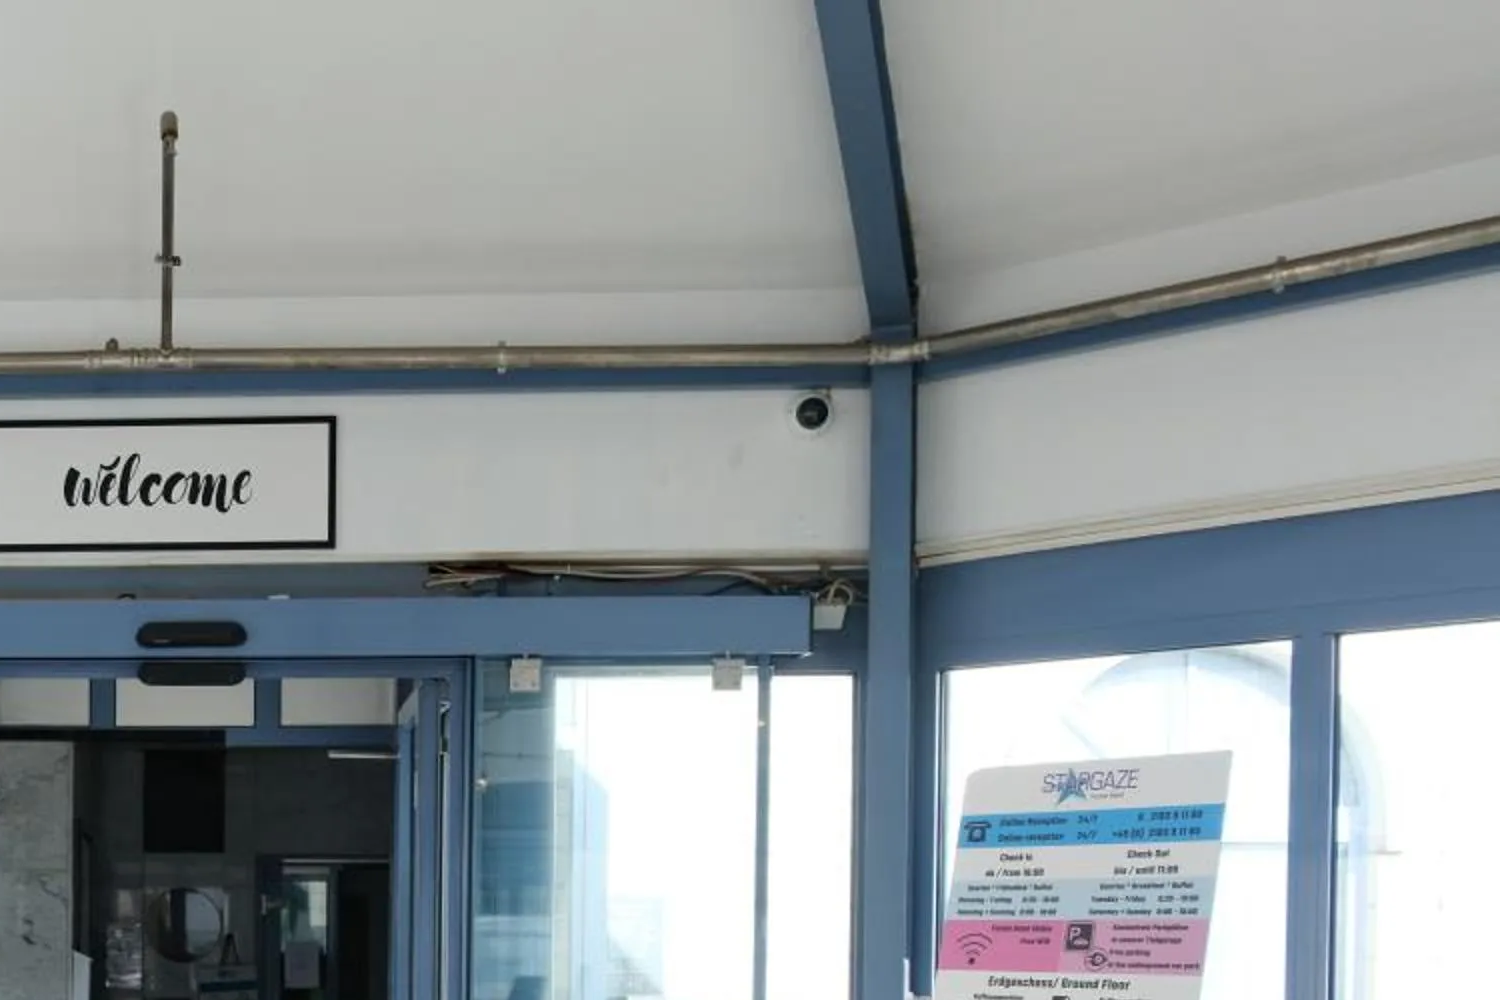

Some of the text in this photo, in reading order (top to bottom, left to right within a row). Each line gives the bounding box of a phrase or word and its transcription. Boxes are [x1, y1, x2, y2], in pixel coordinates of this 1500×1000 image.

[63, 452, 253, 513] welcome
[1041, 768, 1140, 794] STARGAZE
[1061, 977, 1099, 990] Ground
[1100, 979, 1131, 990] Floor
